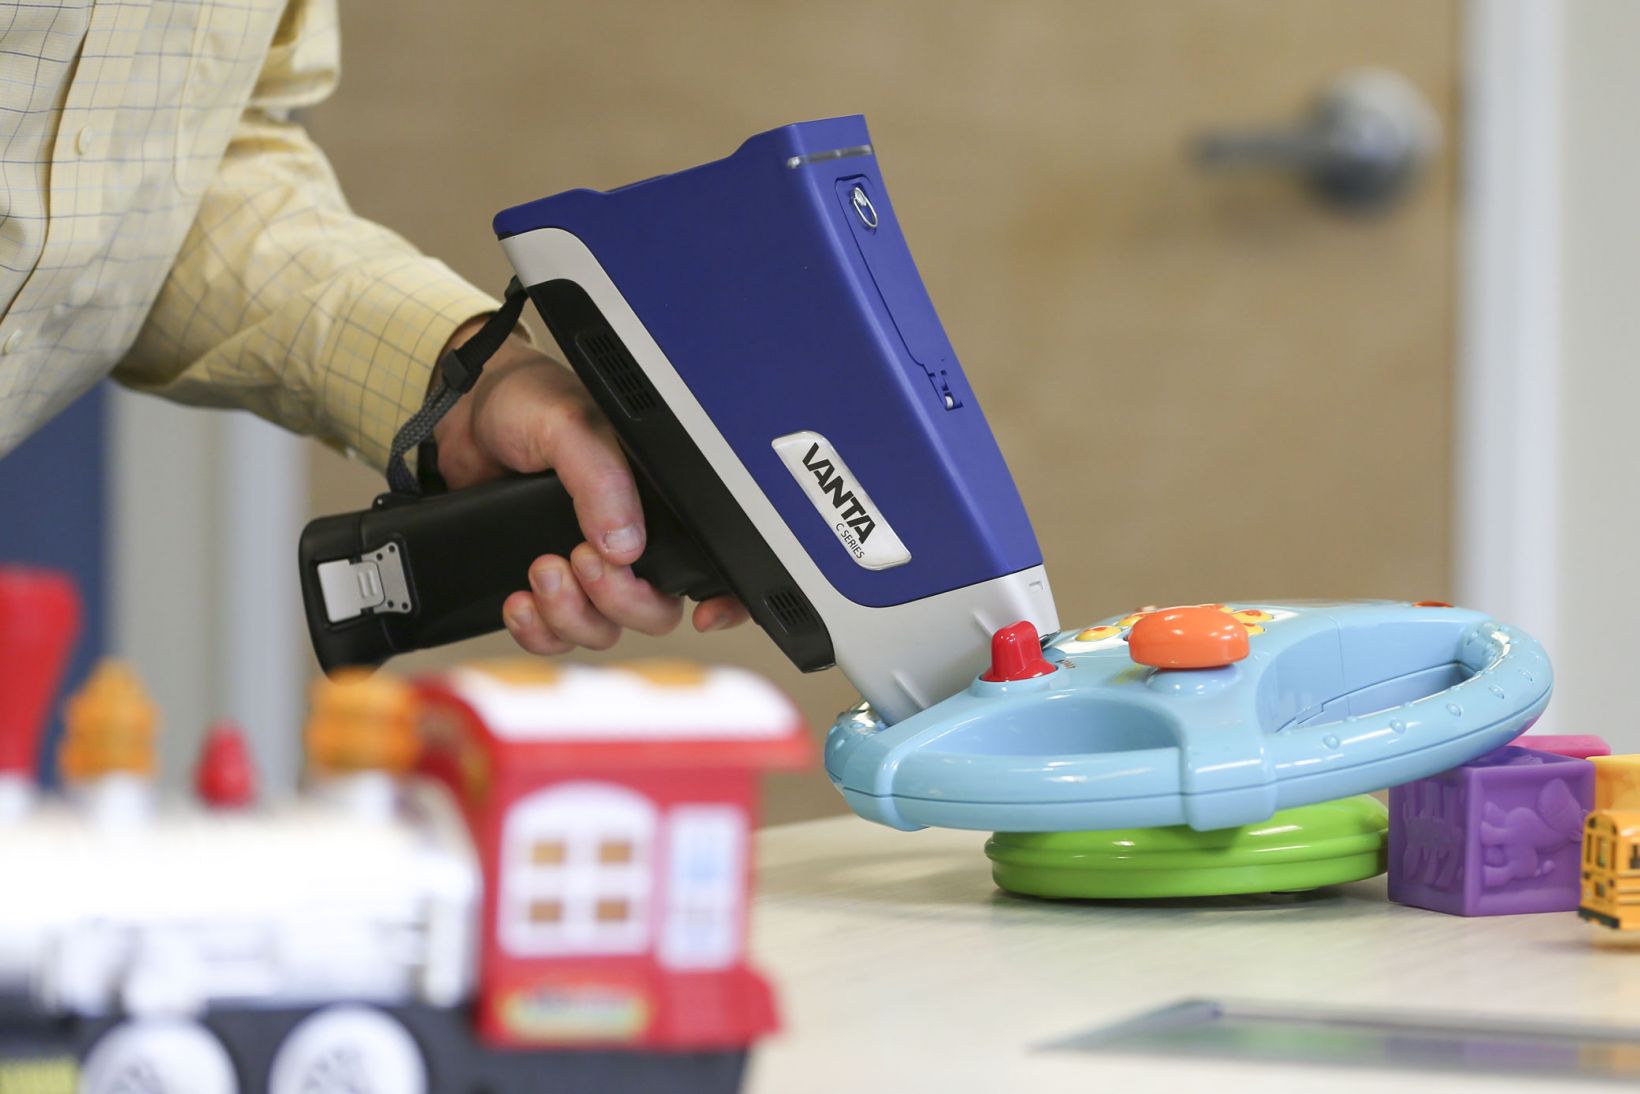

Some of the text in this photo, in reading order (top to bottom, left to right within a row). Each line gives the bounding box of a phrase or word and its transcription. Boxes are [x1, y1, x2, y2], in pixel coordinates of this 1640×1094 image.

[802, 442, 876, 544] VANTA
[835, 522, 865, 559] C SERIES
